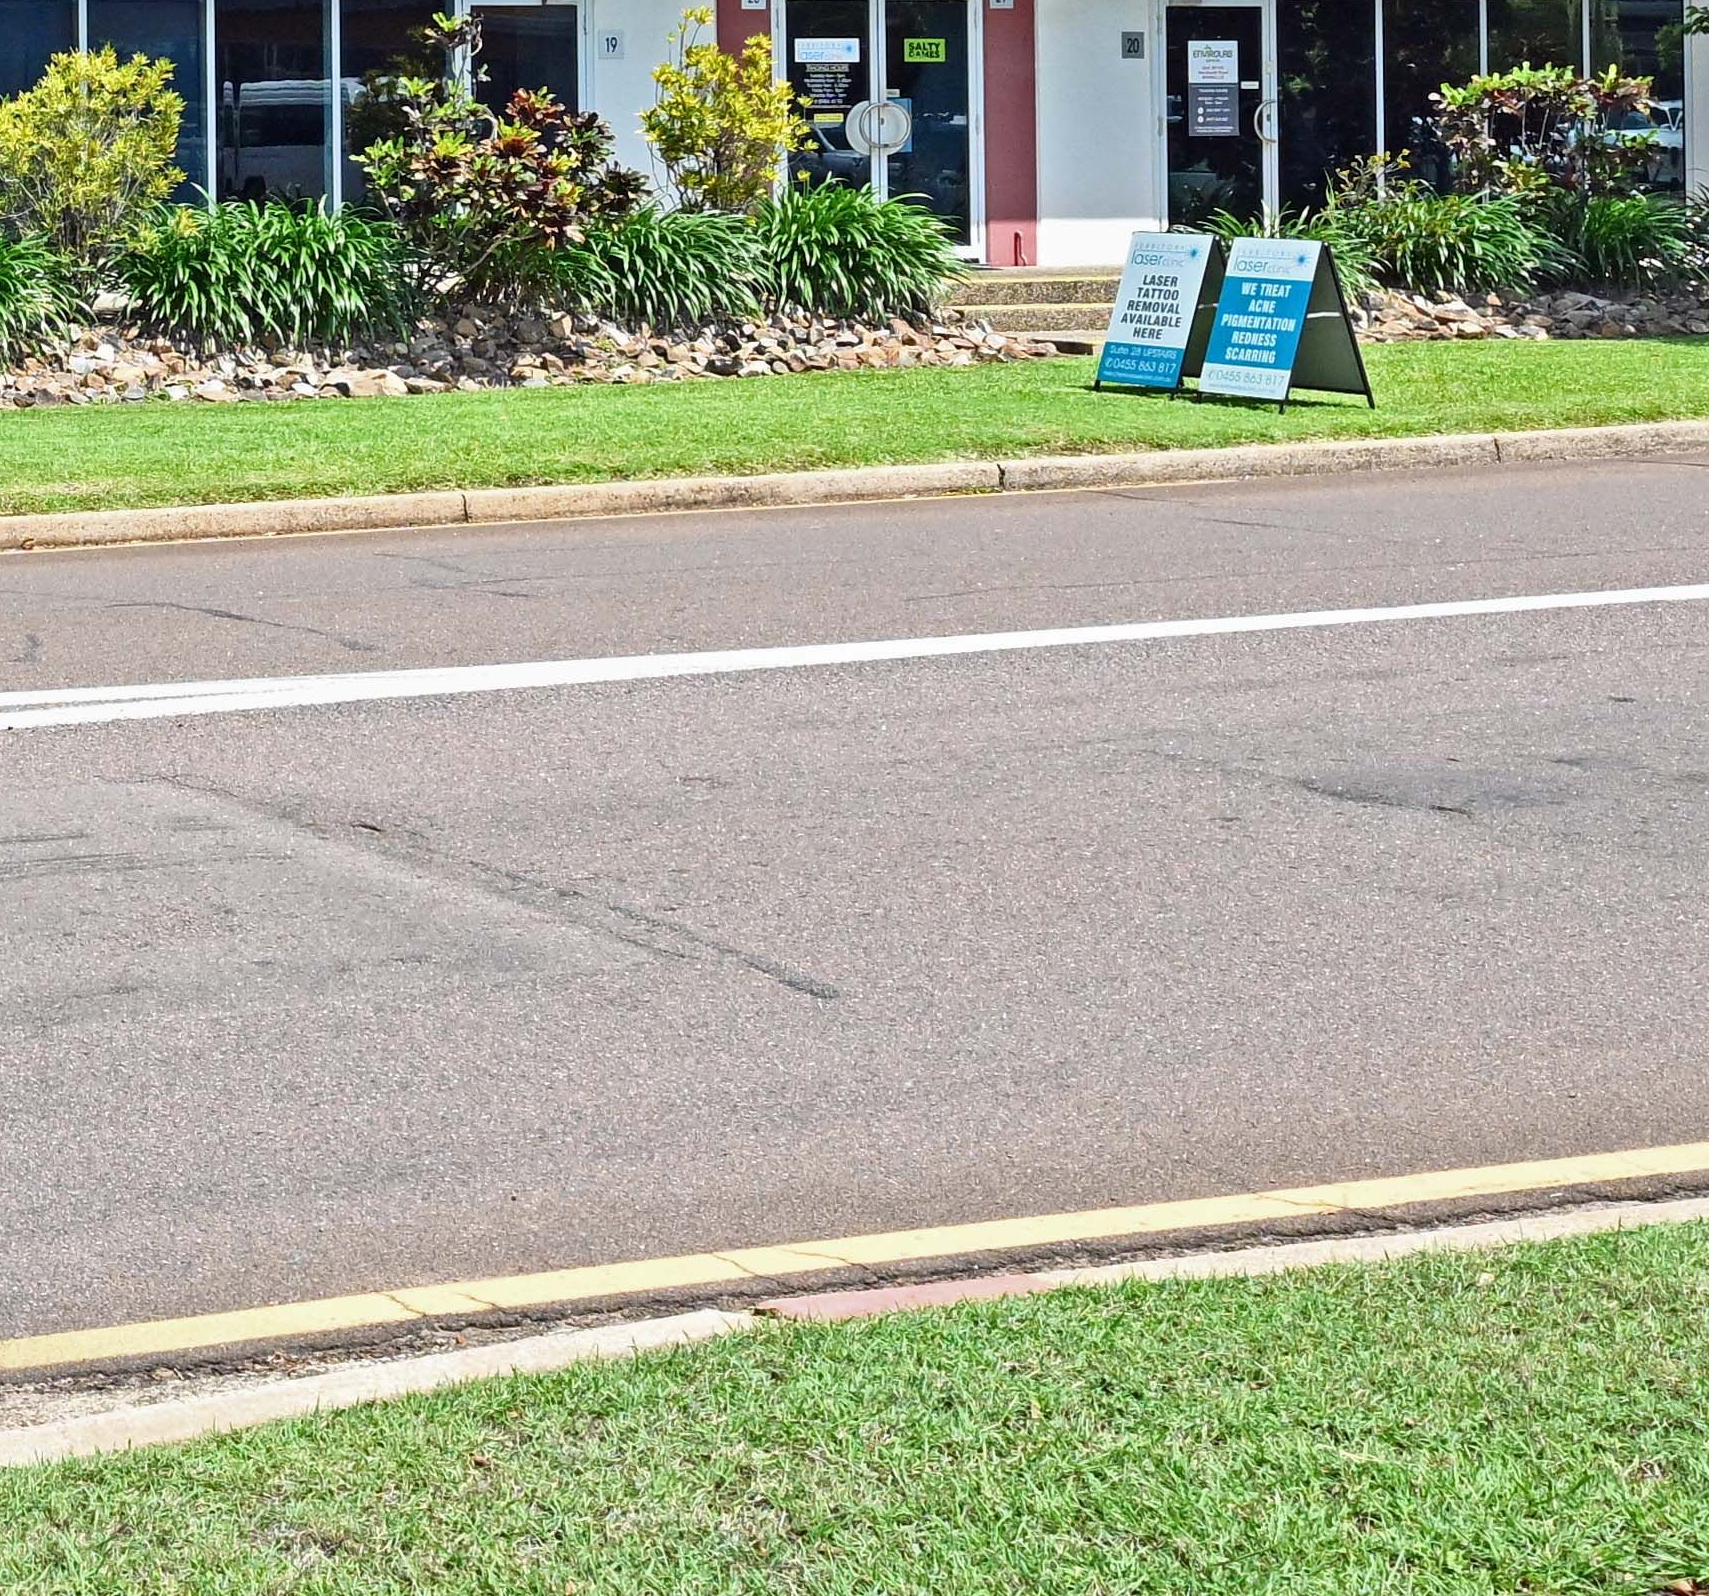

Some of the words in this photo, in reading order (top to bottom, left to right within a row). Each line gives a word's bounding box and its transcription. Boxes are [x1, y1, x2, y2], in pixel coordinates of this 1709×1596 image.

[605, 37, 617, 53] 19
[908, 42, 941, 51] SALTY
[1126, 38, 1140, 54] 20
[1142, 274, 1179, 288] LASER
[1136, 287, 1180, 301] TATTOO
[1241, 282, 1259, 296] WE
[1260, 283, 1292, 299] TREAT
[1126, 300, 1181, 315] REMOVAL
[1248, 299, 1277, 314] ACNE
[1120, 313, 1182, 328] AVAILABLE
[1220, 313, 1297, 332] PIGMENTATION
[1132, 326, 1163, 340] HERE
[1231, 331, 1278, 347] REDNESS
[1224, 346, 1277, 364] SCARRING
[1113, 357, 1138, 370] 0455
[1158, 362, 1177, 374] 817
[1216, 370, 1241, 383] 0455
